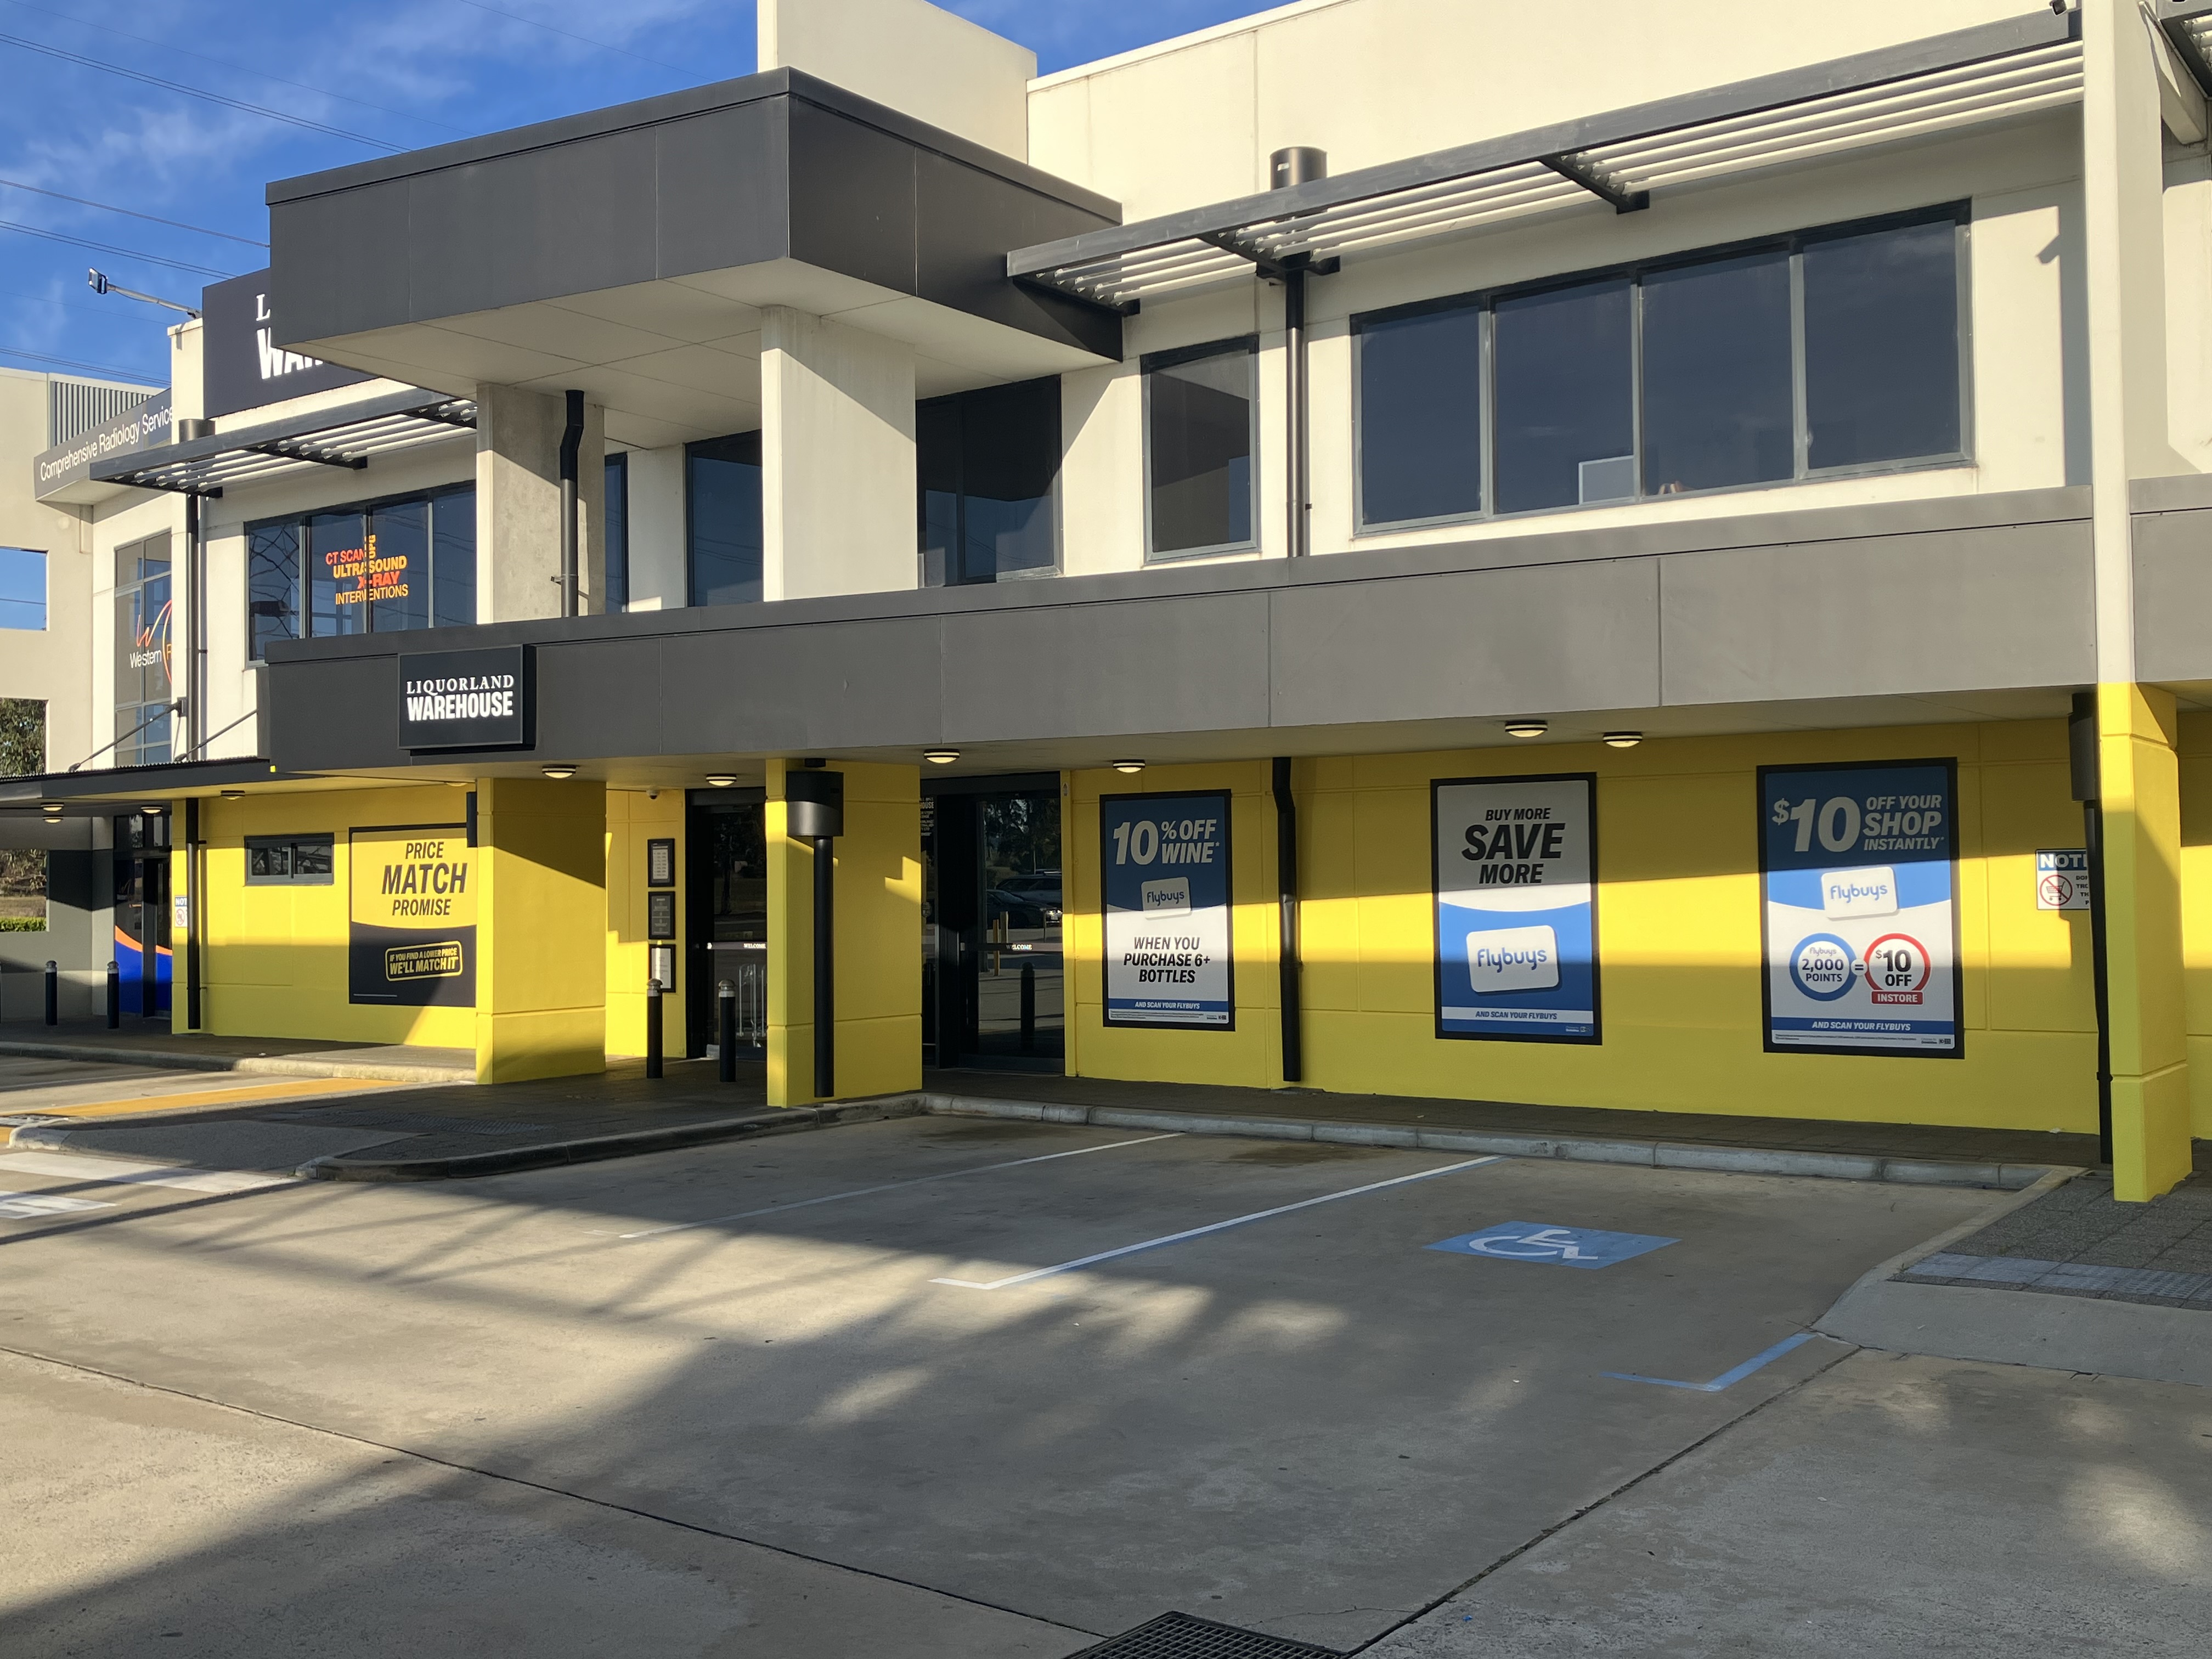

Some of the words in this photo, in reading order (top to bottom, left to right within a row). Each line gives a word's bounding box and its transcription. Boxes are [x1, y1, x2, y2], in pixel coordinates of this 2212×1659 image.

[40, 441, 97, 481] Comprehensive
[99, 420, 140, 454] Radiology
[325, 551, 338, 565] CT
[333, 555, 407, 579] ULTRASOUND
[357, 571, 400, 589] X-RAY
[335, 584, 409, 605] INTERVENTIONS
[129, 650, 162, 669] Western
[406, 674, 514, 696] LIQUORLAND
[407, 691, 514, 722] WAREHOUSE
[1486, 809, 1511, 821] BUY
[1513, 808, 1551, 820] MORE
[1772, 797, 1861, 852] $10
[1866, 797, 1896, 810] OFF
[1899, 795, 1942, 809] YOUR
[1863, 811, 1942, 836] SHOP
[1180, 819, 1217, 840] OFF
[405, 841, 444, 859] PRICE
[1462, 823, 1566, 860] SAVE
[381, 862, 468, 895] MATCH
[1479, 863, 1544, 884] MORE
[1147, 890, 1184, 906] flybuys
[1830, 883, 1888, 904] flybuys
[392, 899, 452, 916] PROMISE
[1134, 936, 1171, 950] WHEN
[1173, 936, 1200, 950] YOU
[1809, 947, 1837, 957] flybuys
[396, 953, 406, 961] YOU
[407, 952, 419, 960] FIND
[424, 949, 442, 958] LOWER
[442, 947, 458, 957] PRICE
[1124, 952, 1192, 967] PURCHASE
[1194, 953, 1210, 967] 6+
[1477, 947, 1547, 973] flybuys
[1802, 958, 1844, 972] 2,000
[1875, 949, 1912, 972] $10
[390, 961, 414, 975] WE'LL
[415, 957, 446, 972] MATCH
[1139, 969, 1196, 983] BOTTLES
[1806, 973, 1842, 982] POINTS
[1885, 974, 1912, 986] OFF
[1877, 994, 1918, 1003] INSTORE
[1876, 1023, 1911, 1031] FLYBUYS
